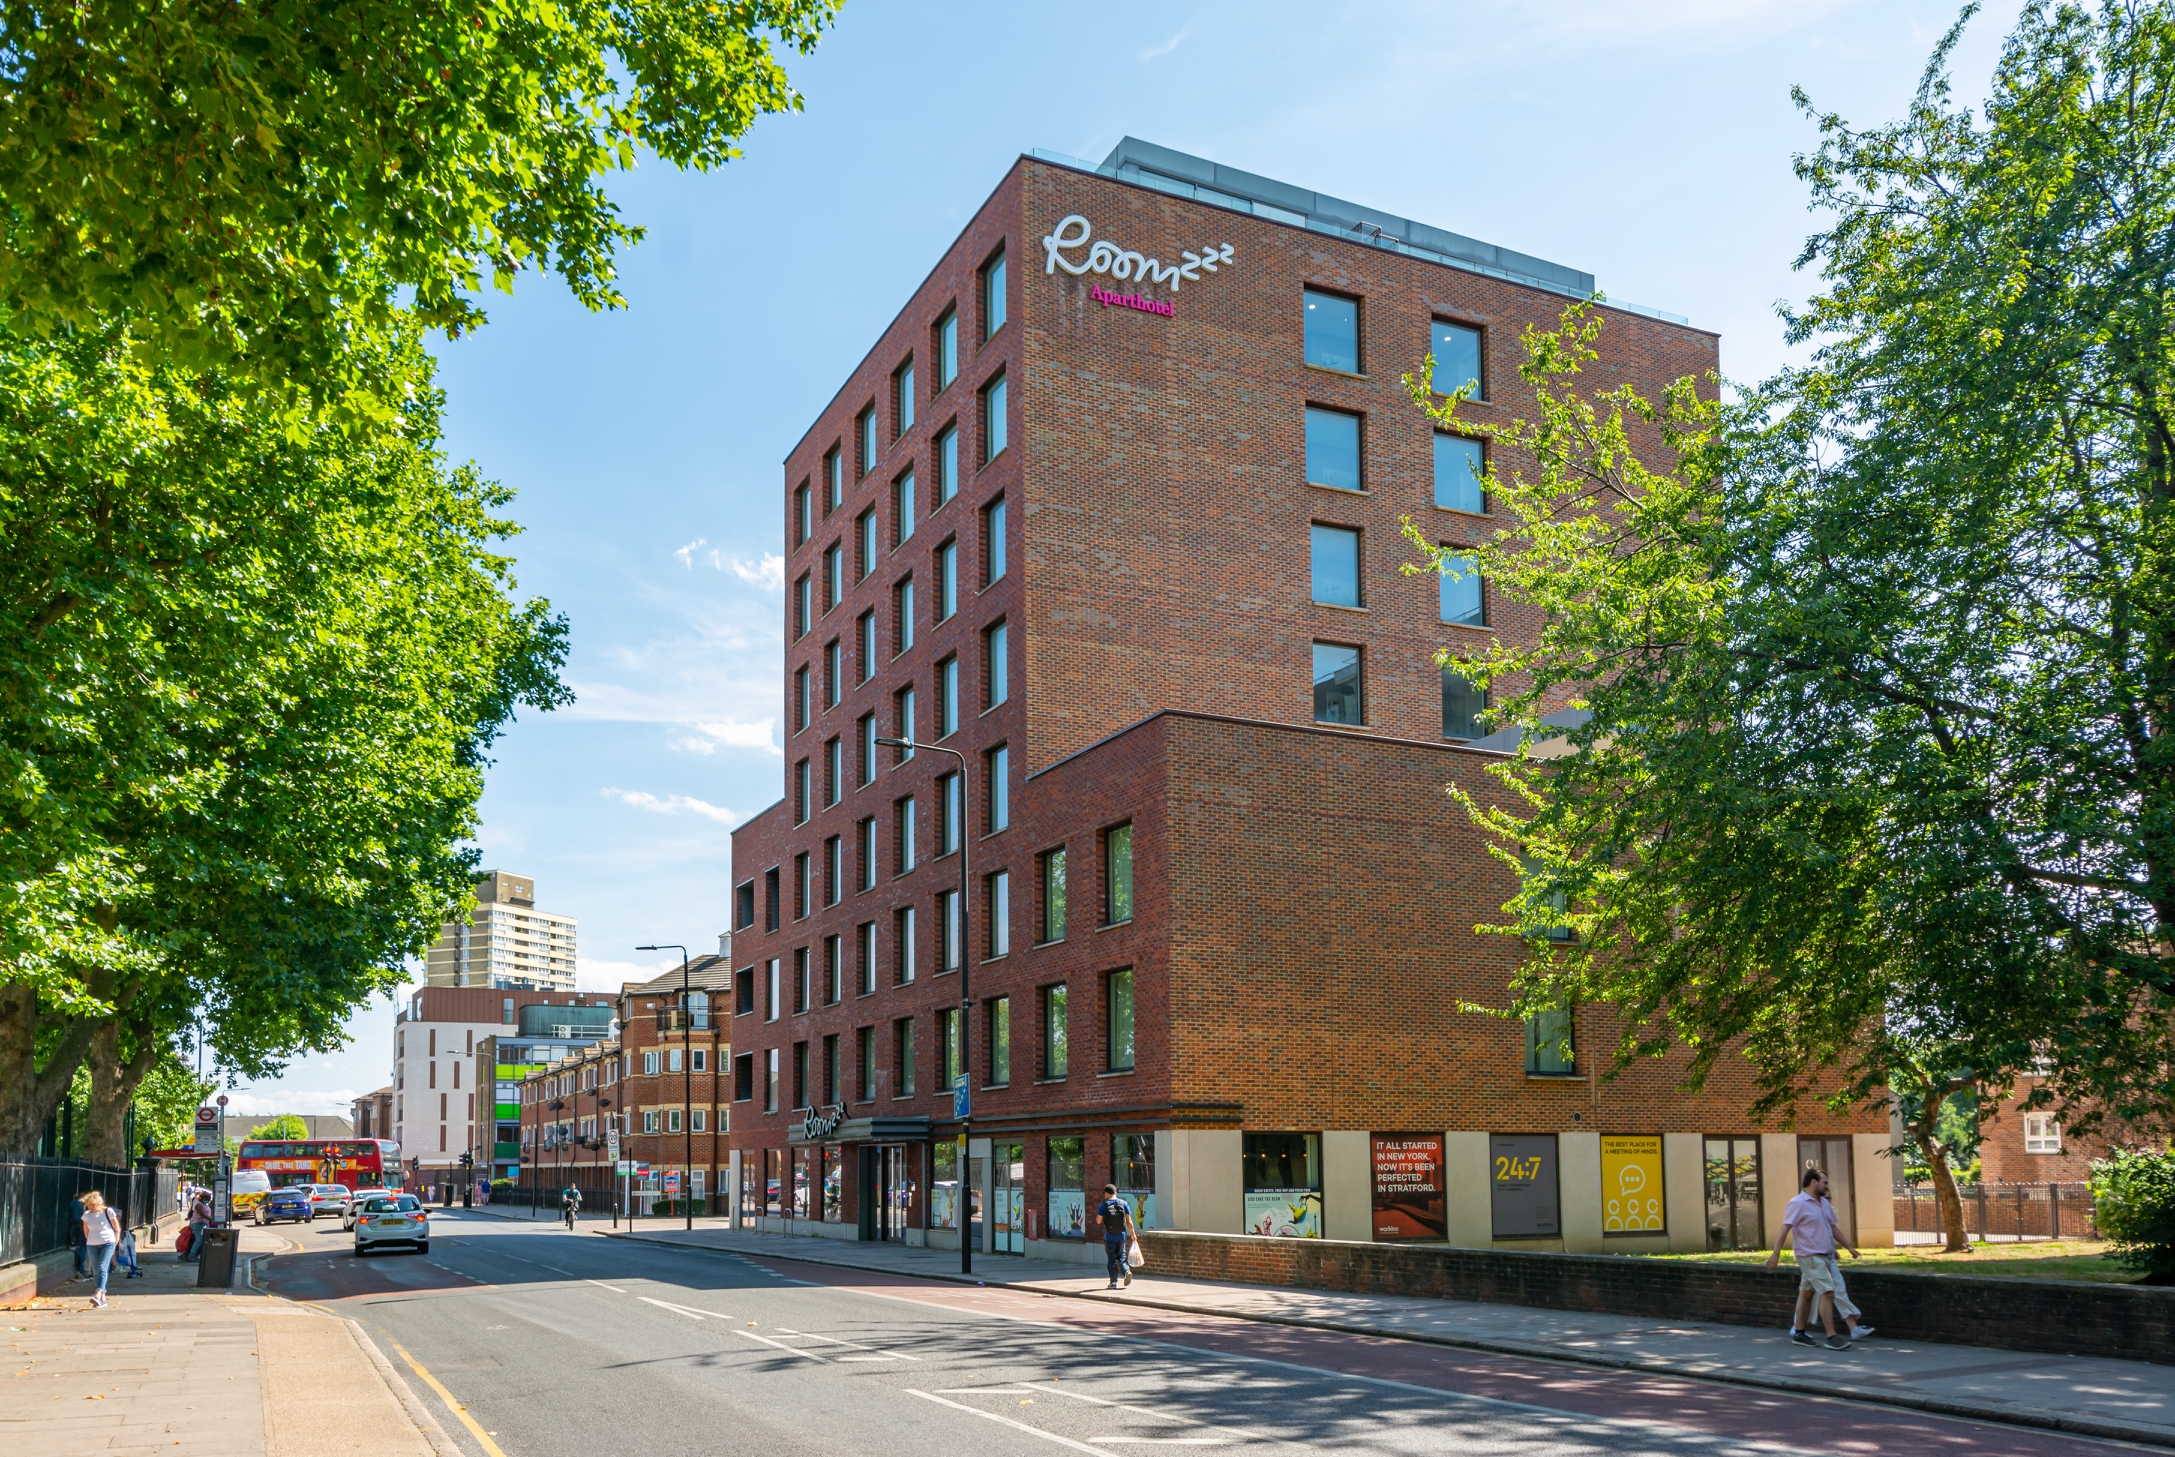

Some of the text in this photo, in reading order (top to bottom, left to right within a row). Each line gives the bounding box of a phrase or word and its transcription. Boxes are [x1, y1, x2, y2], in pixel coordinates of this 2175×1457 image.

[1042, 214, 1235, 292] Roomzzz
[1090, 284, 1175, 317] Aparthotel
[804, 1102, 844, 1139] Roomzzz
[1376, 1142, 1384, 1150] IT
[264, 1161, 281, 1170] SHAKE
[1377, 1163, 1397, 1171] NOW
[1495, 1156, 1541, 1180] 24:7
[1387, 1184, 1435, 1192] STRATFORD.
